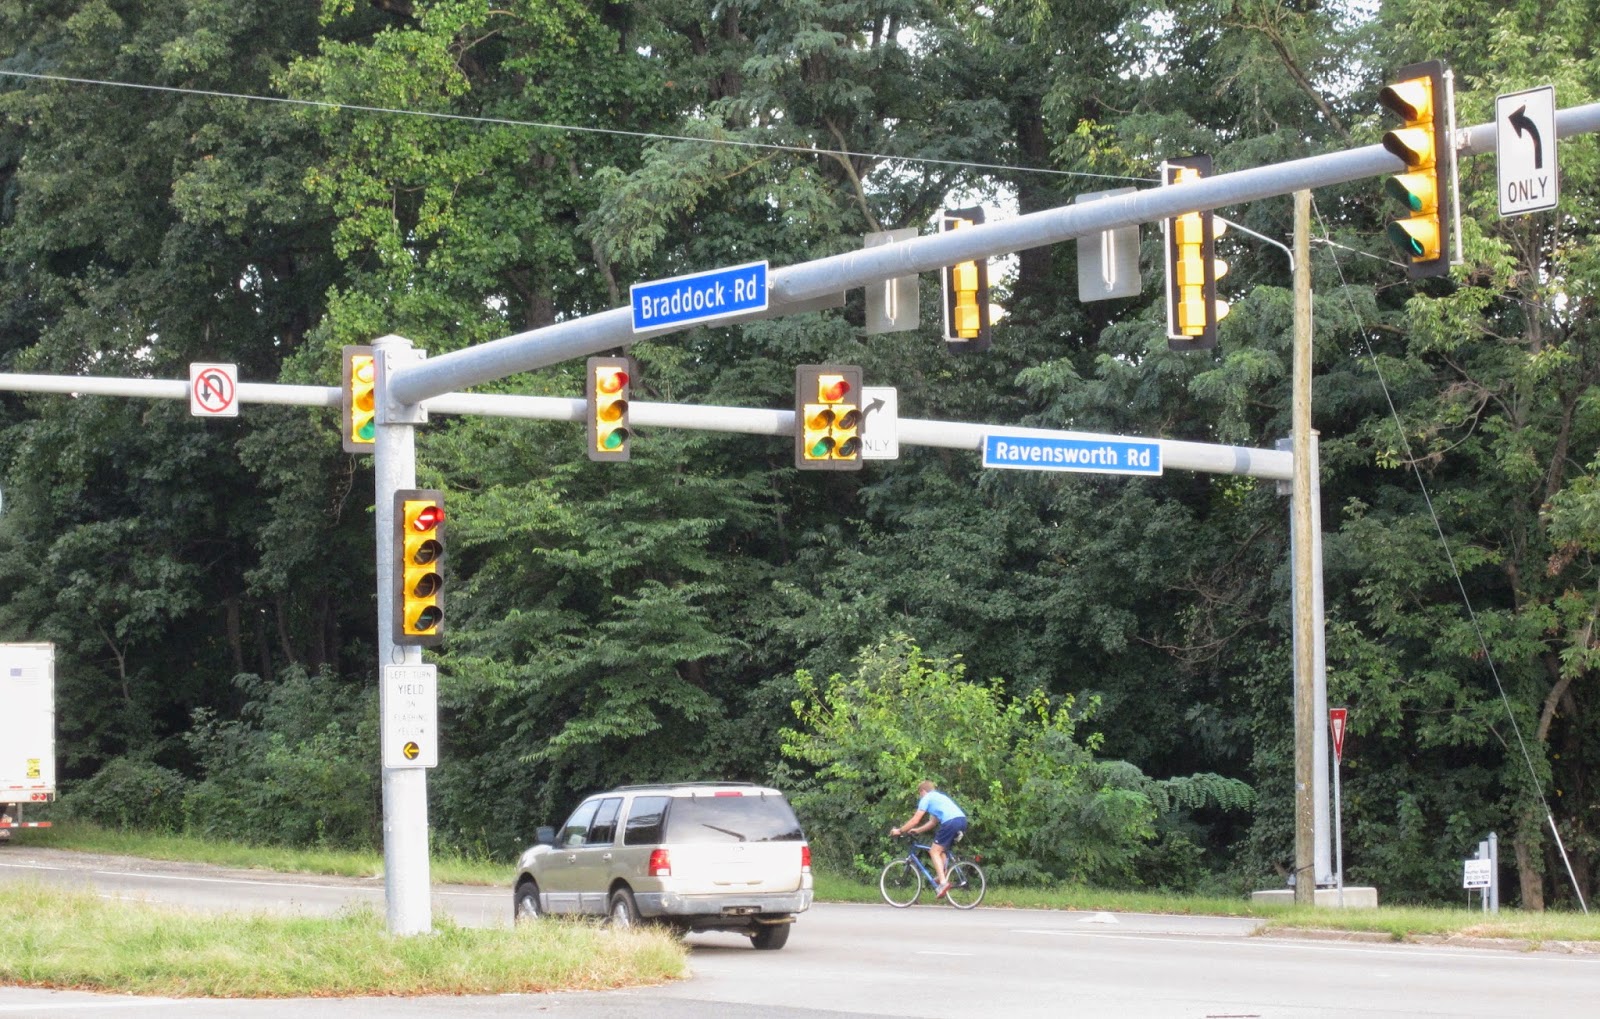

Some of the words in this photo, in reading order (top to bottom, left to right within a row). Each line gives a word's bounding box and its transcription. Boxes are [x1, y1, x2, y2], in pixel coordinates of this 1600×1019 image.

[1508, 176, 1548, 203] ONLY
[641, 281, 725, 319] Braddock
[734, 274, 757, 302] Rd
[865, 440, 889, 451] NLY
[996, 442, 1118, 465] Ravensworth
[1127, 449, 1150, 467] Rd
[390, 671, 406, 679] LEFT
[413, 671, 431, 679] TURN
[398, 684, 424, 695] YIELD
